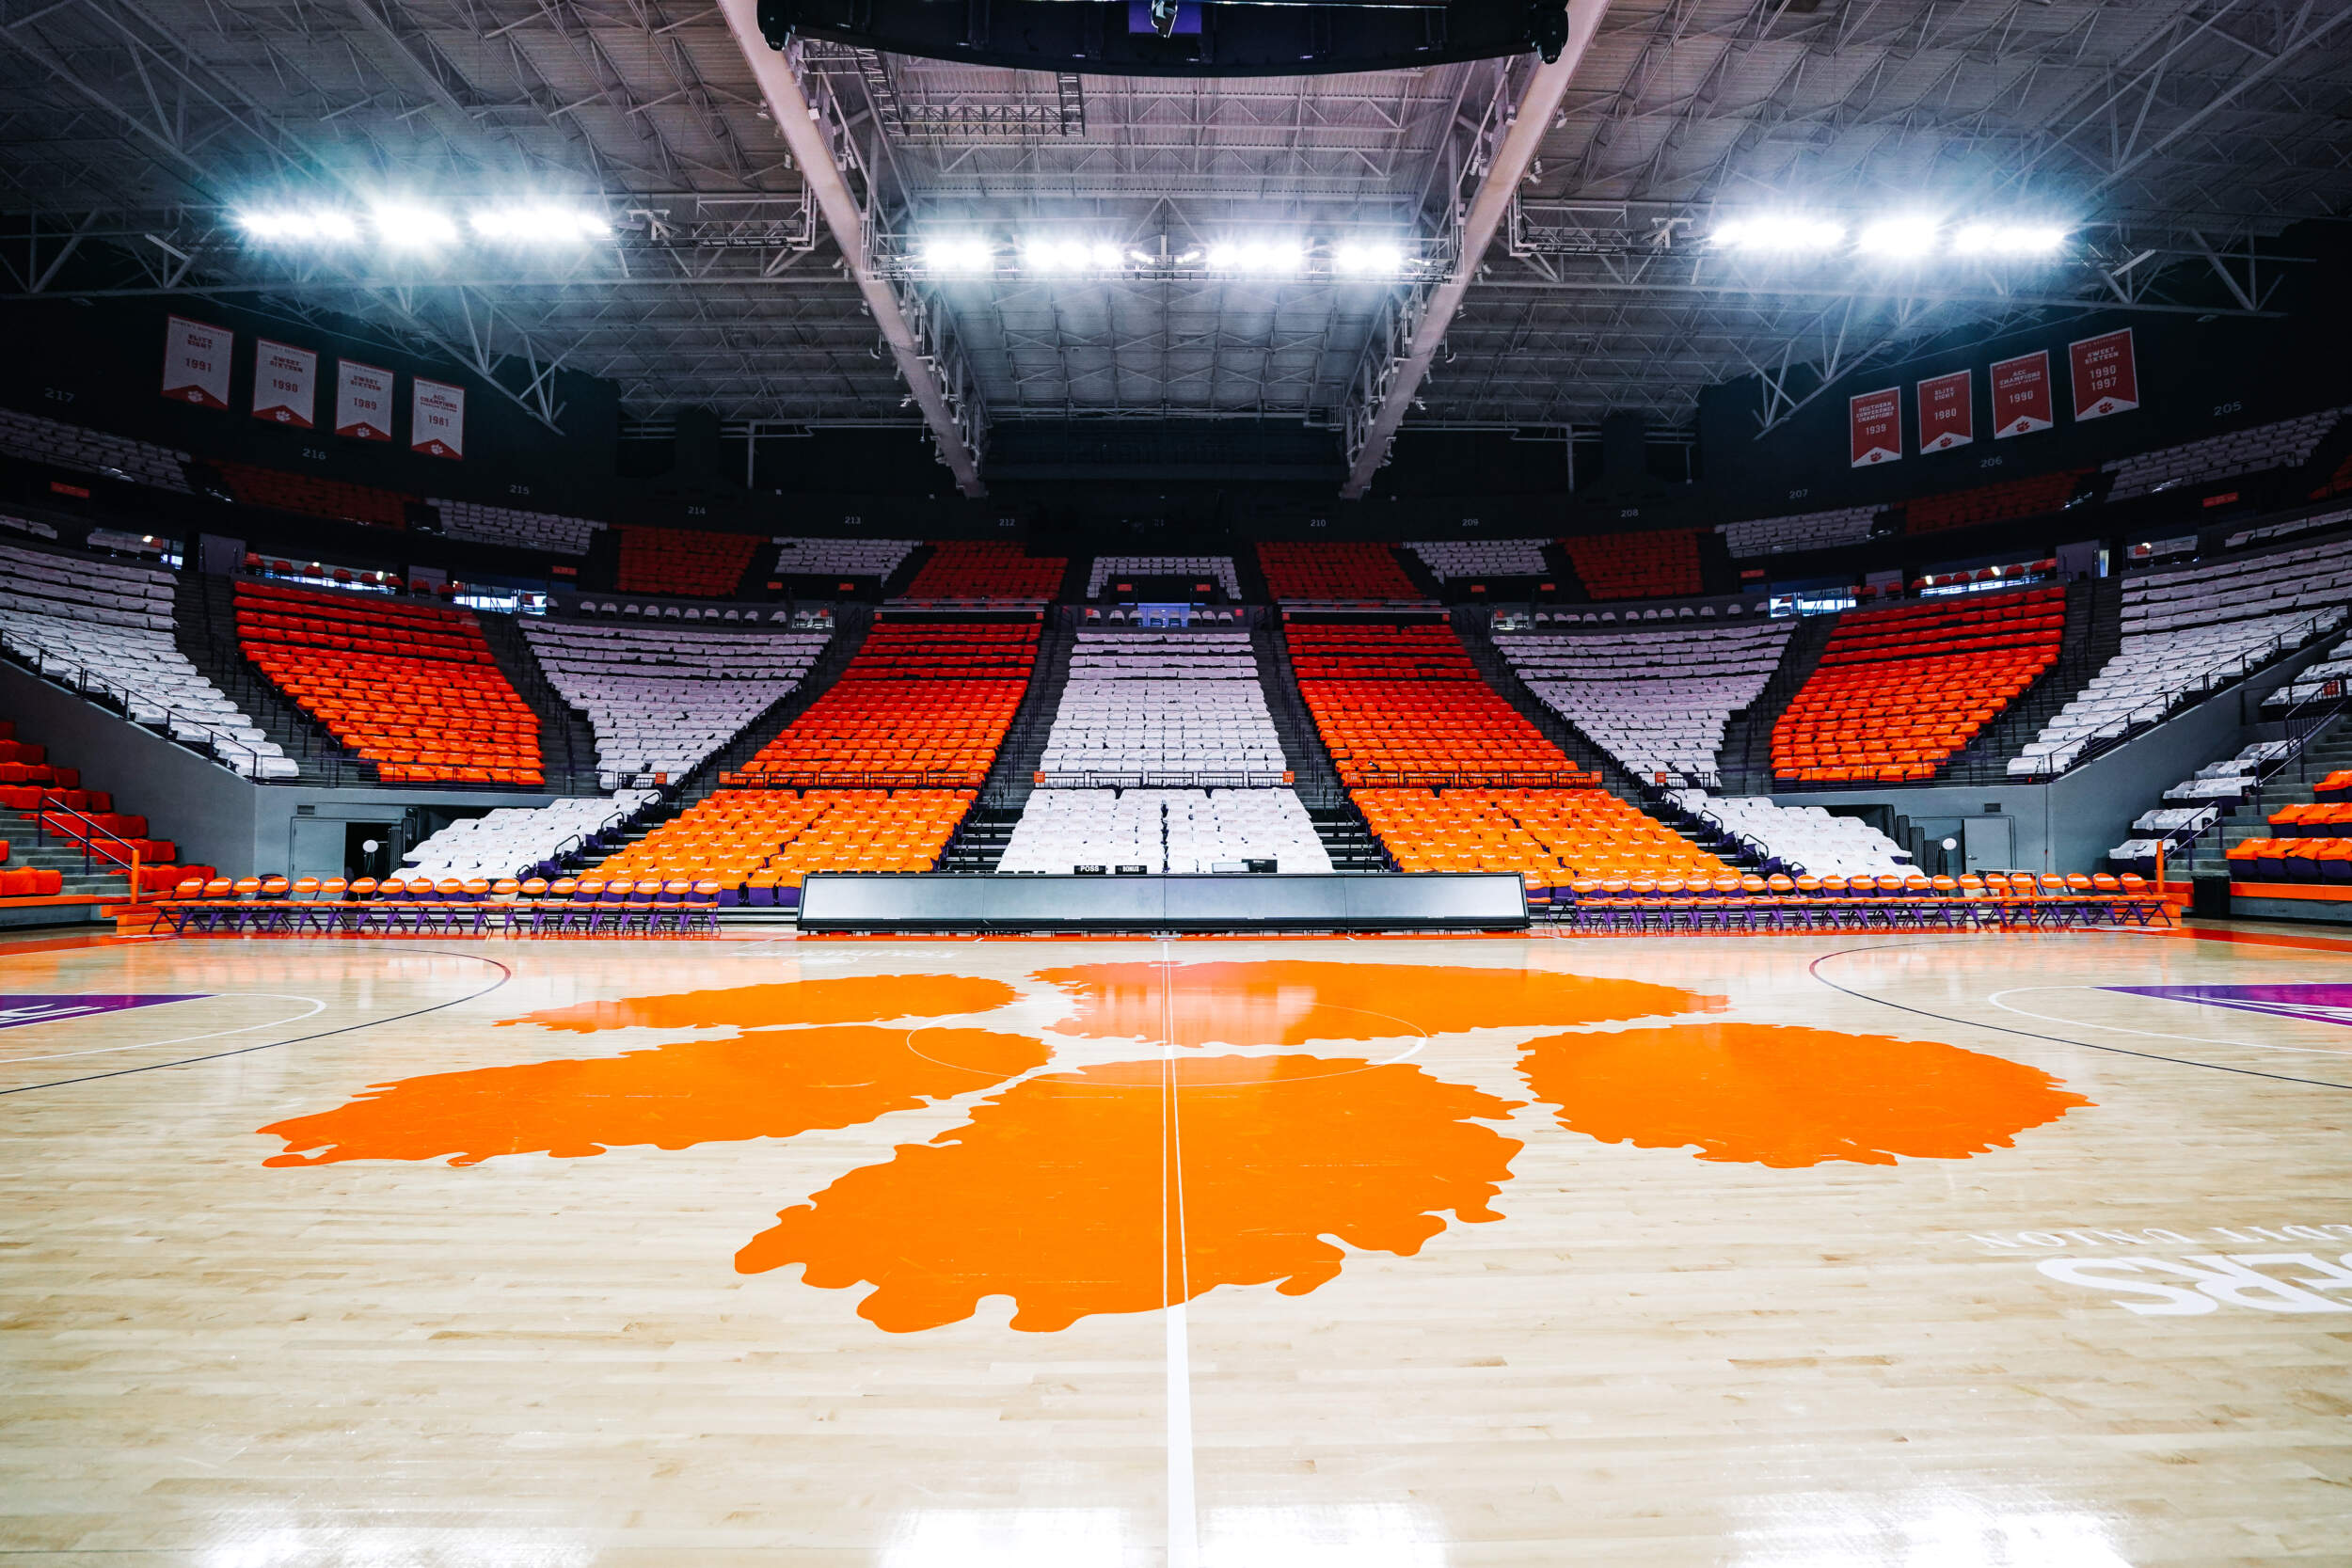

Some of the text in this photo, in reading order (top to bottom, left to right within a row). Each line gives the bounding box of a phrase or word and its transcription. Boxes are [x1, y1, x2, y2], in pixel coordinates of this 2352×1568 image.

[2085, 351, 2118, 365] SIXTEEN
[2087, 346, 2115, 358] SWEET
[185, 357, 213, 373] 1991
[2090, 364, 2116, 380] 1990
[1999, 371, 2041, 387] CHAMPIONS
[2011, 369, 2026, 377] ACC
[273, 378, 298, 393] 1990
[2090, 376, 2117, 391] 1997
[44, 387, 75, 404] 217
[420, 396, 458, 409] CHAMPIONS
[2009, 390, 2033, 405] 1990
[354, 397, 377, 412] 1989
[2214, 401, 2243, 417] 205
[429, 414, 450, 428] 1981
[1934, 407, 1957, 421] 1980
[1866, 423, 1887, 437] 1939
[302, 447, 327, 462] 216
[1979, 456, 2003, 469] 206
[509, 483, 531, 496] 215
[1788, 489, 1808, 500] 207
[688, 505, 707, 516] 214
[1620, 508, 1640, 517] 208
[844, 515, 863, 526] 213
[998, 518, 1016, 528] 212
[1310, 518, 1327, 528] 210
[1461, 518, 1480, 528] 209
[1959, 1227, 2196, 1248] UNION
[2036, 1252, 2352, 1317] ERS
